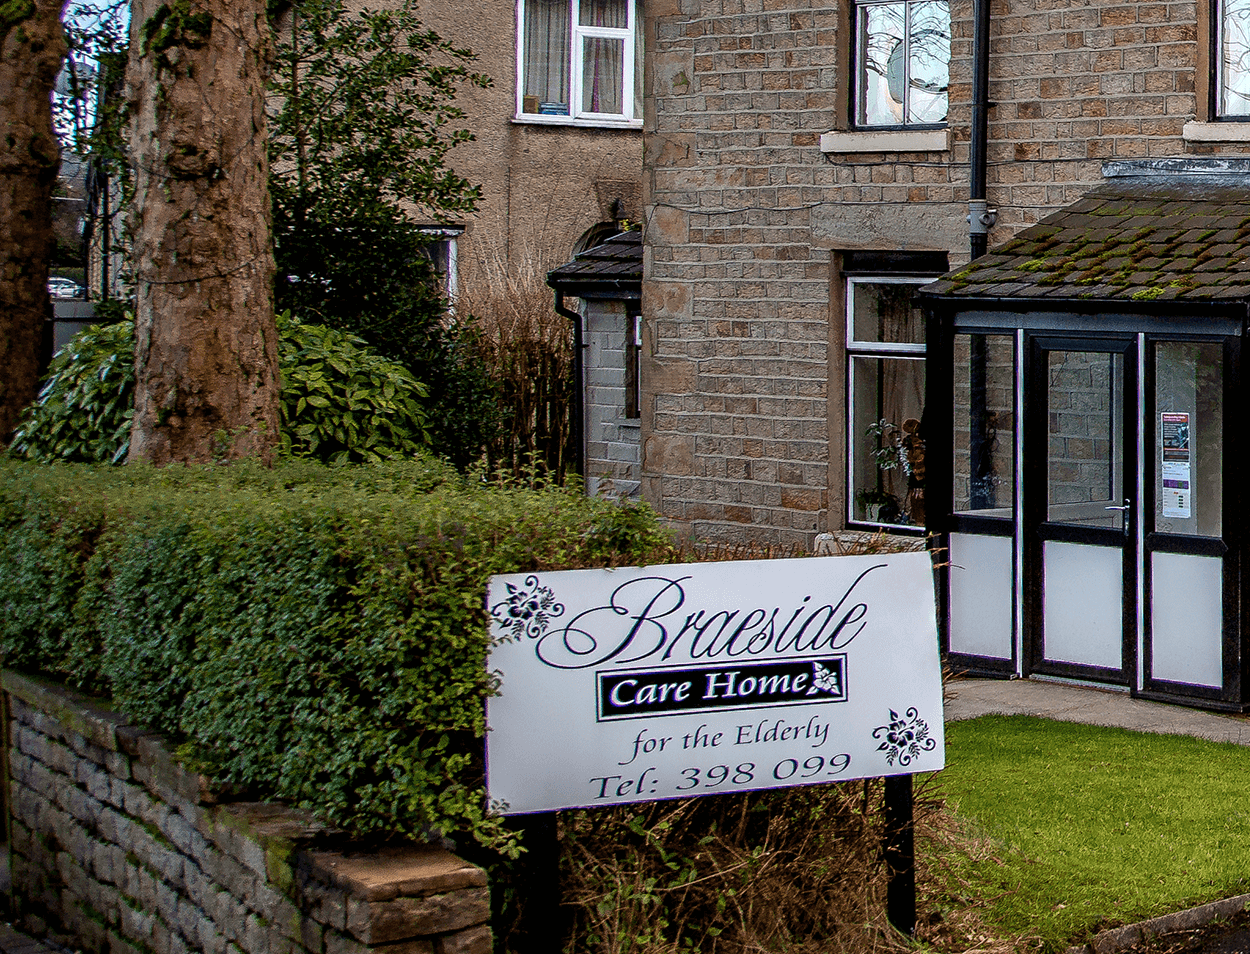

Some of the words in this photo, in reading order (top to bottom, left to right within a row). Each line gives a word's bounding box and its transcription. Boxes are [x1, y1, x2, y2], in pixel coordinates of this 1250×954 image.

[535, 563, 888, 669] Braeside
[609, 678, 690, 707] Care
[702, 670, 808, 702] Home
[617, 728, 672, 765] for
[682, 721, 723, 748] the
[734, 715, 830, 748] Elderly
[589, 768, 658, 800] Tel:
[675, 762, 756, 791] 398
[772, 752, 852, 779] 099
